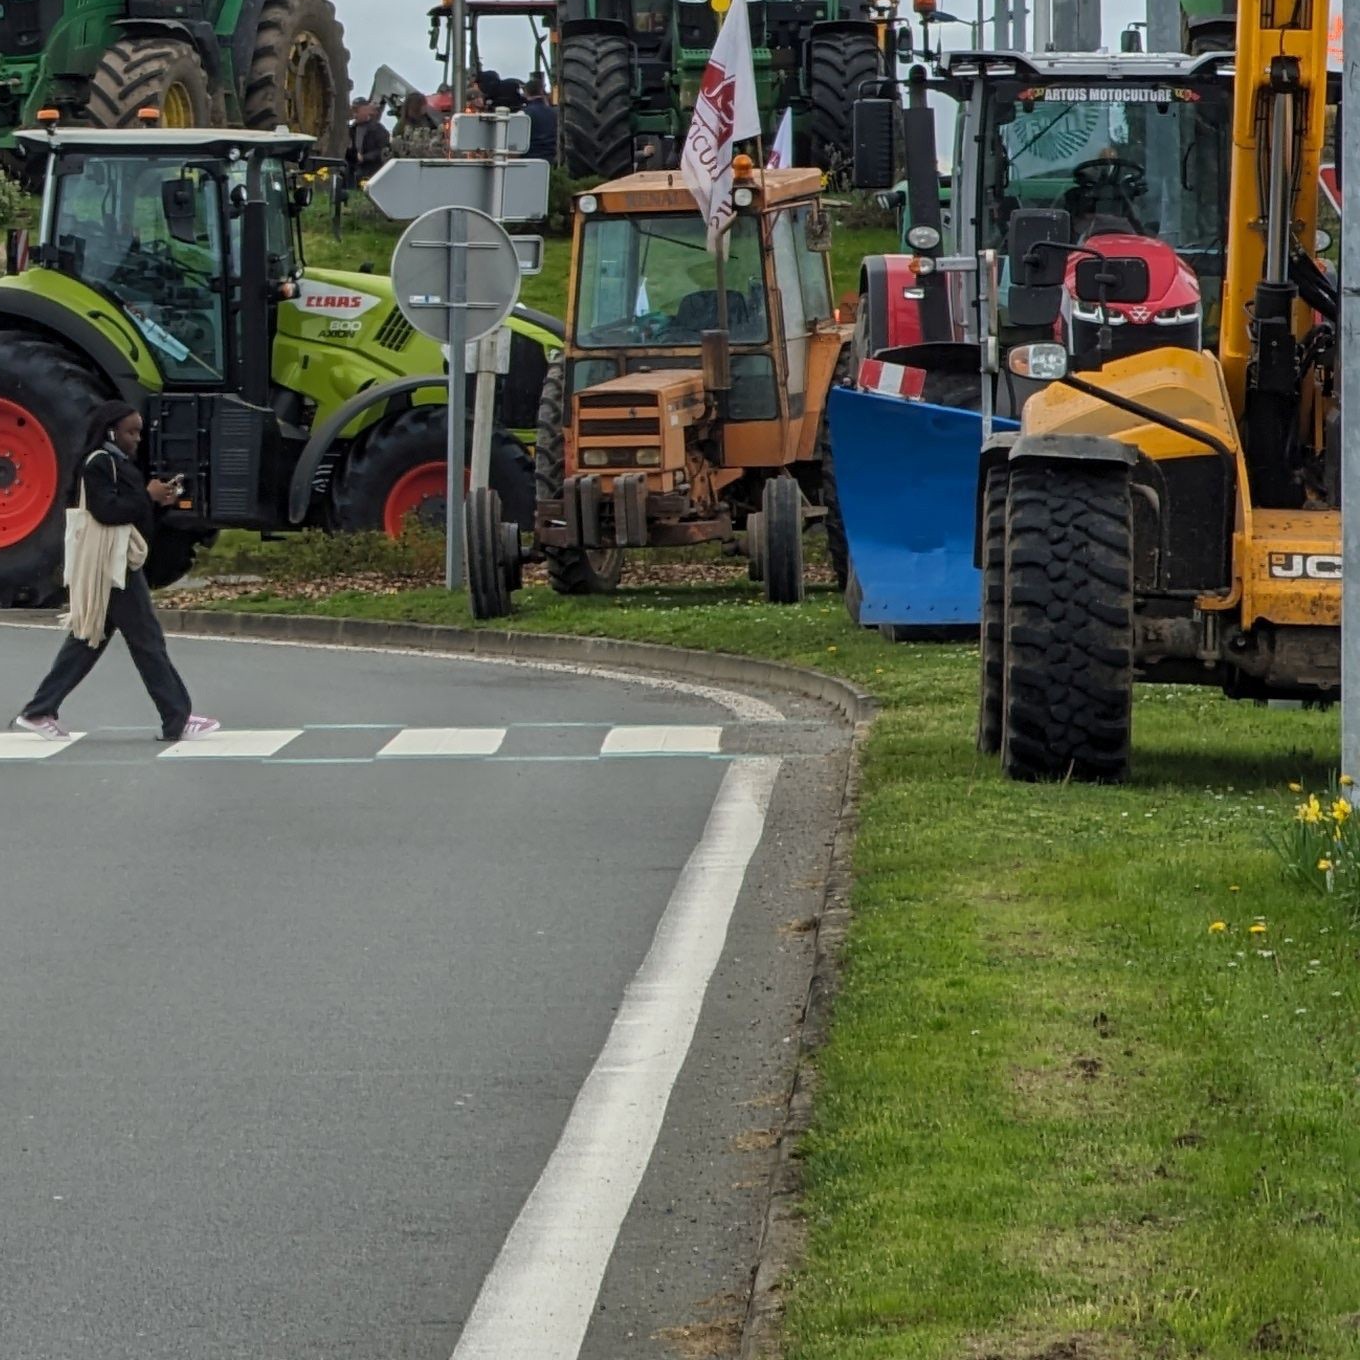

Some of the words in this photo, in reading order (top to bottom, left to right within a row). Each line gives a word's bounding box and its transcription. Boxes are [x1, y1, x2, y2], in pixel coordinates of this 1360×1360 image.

[1045, 89, 1087, 101] ARTOIS
[1089, 89, 1172, 102] MOTOCULTURE
[305, 296, 362, 307] CLAAS
[330, 321, 361, 330] 800
[1271, 554, 1343, 578] JC
